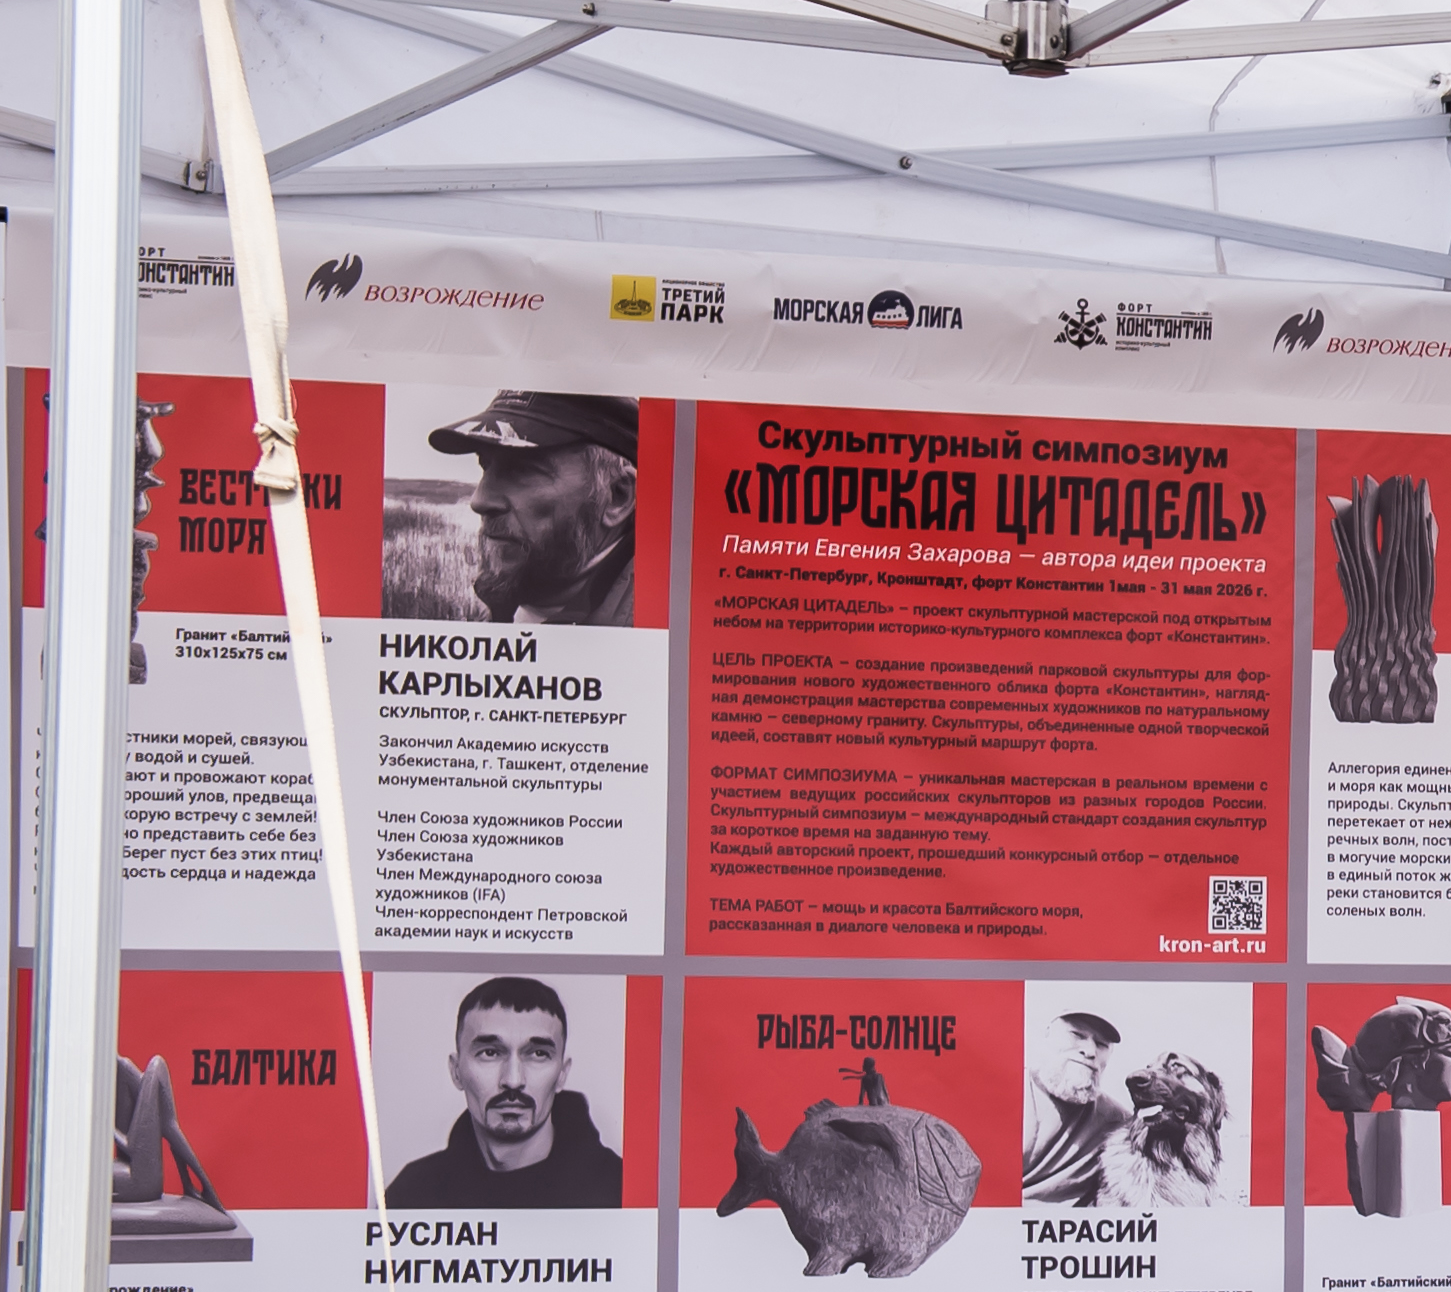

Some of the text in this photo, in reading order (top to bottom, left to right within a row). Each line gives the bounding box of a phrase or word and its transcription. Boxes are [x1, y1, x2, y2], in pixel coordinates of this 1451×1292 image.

[138, 246, 166, 258] ОРТ
[662, 287, 725, 304] ТРЕТИЙ
[1118, 302, 1152, 313] ФОРТ
[661, 302, 724, 324] ПАРК
[773, 298, 963, 329] МОРСКАЯ ЛИГА
[1116, 313, 1213, 340] КОНСТАНТИН
[758, 420, 1228, 475] Скульптурный симпозиум
[178, 516, 267, 555] МОРЯ
[723, 535, 1266, 575] Памяти Евгения Захарова автора идеи проекта
[380, 631, 537, 662] НИКОЛАЙ
[379, 671, 602, 701] КАРЛЫХАНОВ
[379, 706, 627, 725] СКУЛЬПТОР, г. САНКТ-ПЕТЕРБУРГ
[1160, 935, 1266, 953] kron-art.ru
[757, 1014, 956, 1057] РЫБА-СОЛНЦЕ
[191, 1049, 336, 1086] БАЛТИКА
[364, 1219, 501, 1249] РУСЛАН
[1022, 1213, 1157, 1243] ТАРАСИЙ
[363, 1255, 615, 1287] НИГМАТУЛЛИН
[1021, 1255, 1156, 1279] ТРОШИН
[1322, 1277, 1367, 1291] Гранит
